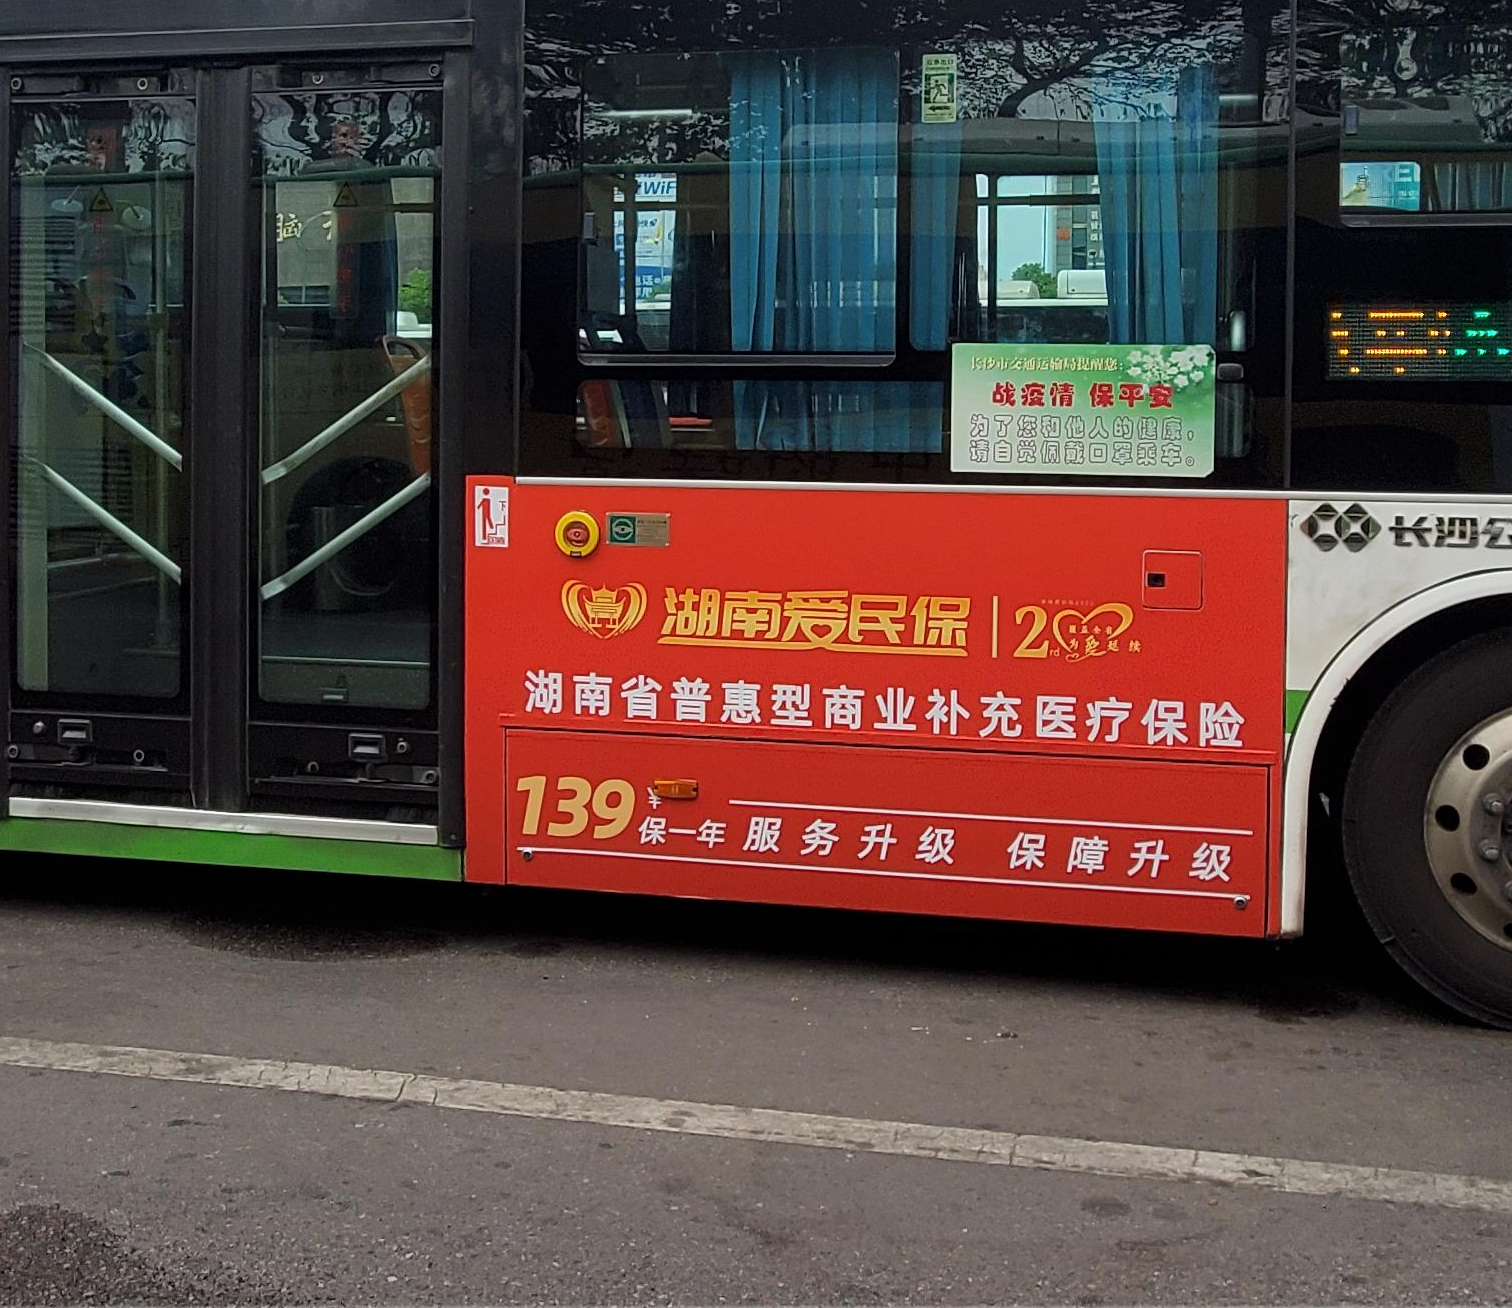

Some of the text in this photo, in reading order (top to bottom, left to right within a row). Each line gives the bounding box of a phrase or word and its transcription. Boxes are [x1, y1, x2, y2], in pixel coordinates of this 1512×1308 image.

[991, 381, 1174, 408] 战疫情 保平安
[969, 439, 1195, 467] 请自觉佩戴口罩乘车。
[970, 413, 1195, 442] 为了您和他人的健康，
[657, 587, 970, 657] 湖南爱民保
[523, 669, 1246, 748] 湖南省普惠型商业补充医疗保险
[515, 775, 635, 839] 139
[638, 816, 1233, 882] 保一年 服务升级 保障升级
